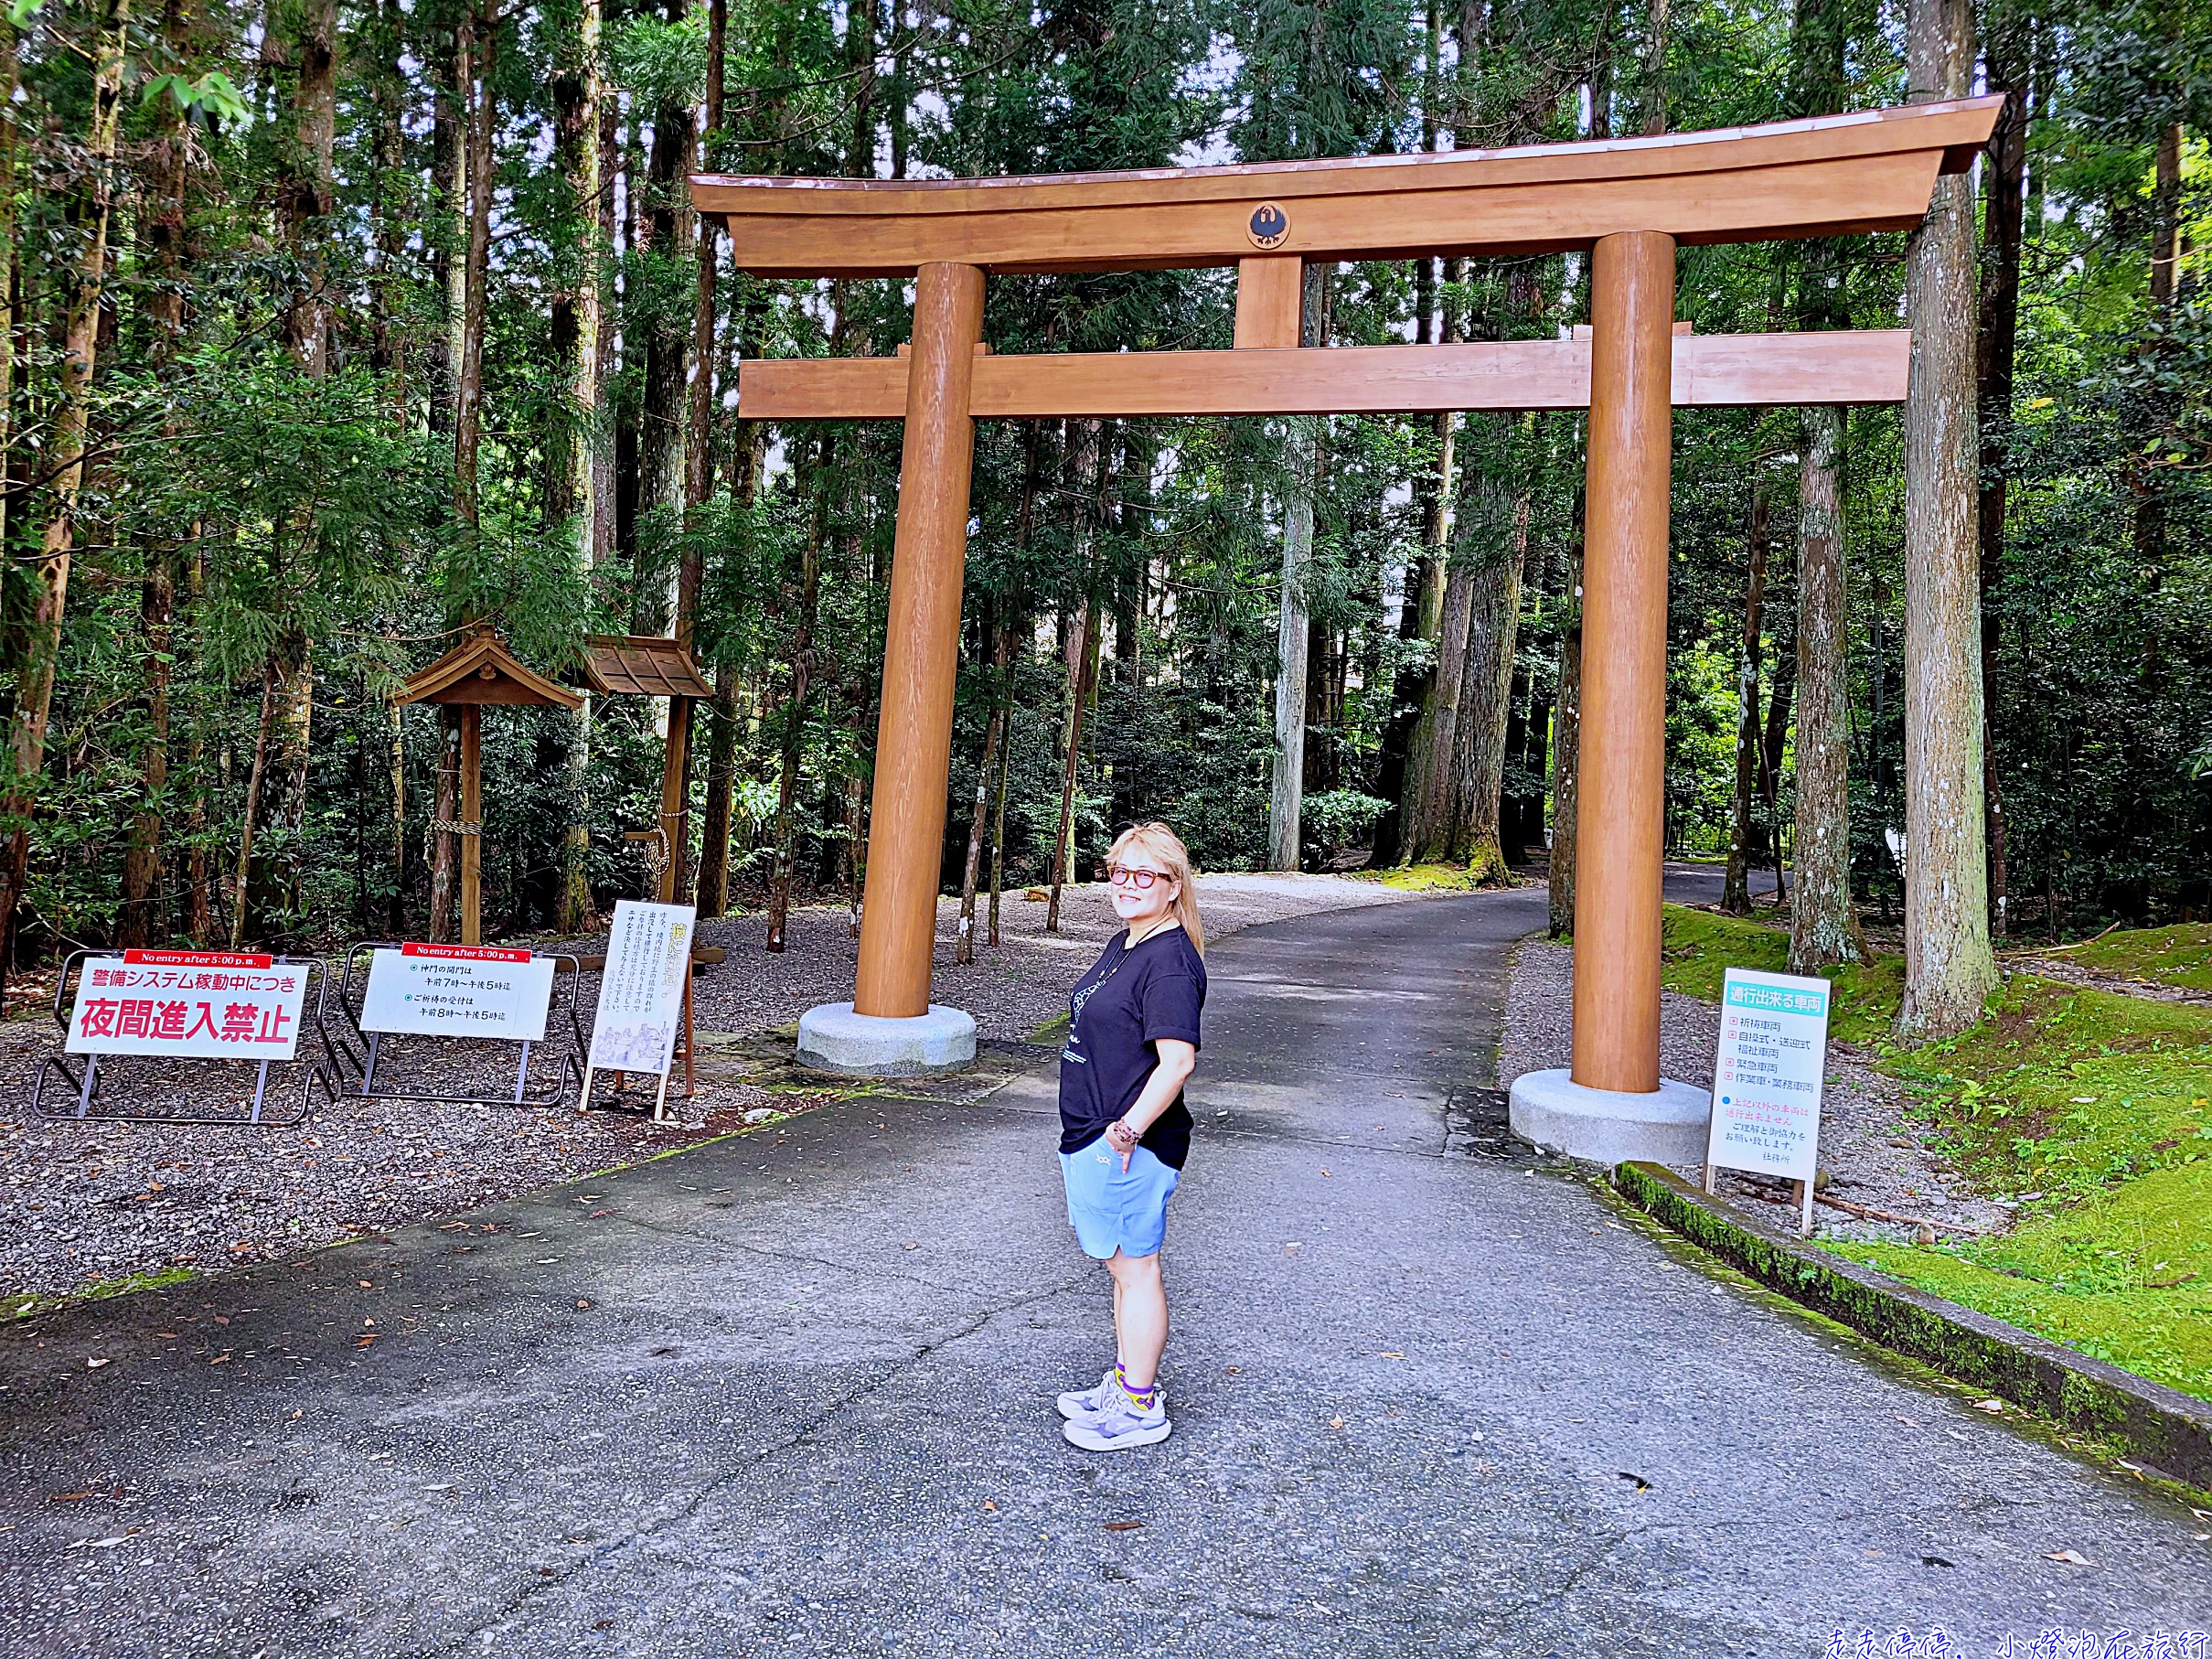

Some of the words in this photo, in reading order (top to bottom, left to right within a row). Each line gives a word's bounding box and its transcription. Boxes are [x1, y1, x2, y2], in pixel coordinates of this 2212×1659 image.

[142, 953, 155, 961] No
[156, 955, 183, 963] entry
[185, 955, 209, 964] after
[211, 956, 233, 964] 5:00
[235, 958, 257, 966] p.m.
[430, 947, 454, 956] entry
[454, 949, 476, 958] after
[478, 950, 497, 958] 5:00
[91, 969, 296, 993] 警備システム稼動中につき
[1730, 986, 1822, 1012] 通行出来る車両
[80, 997, 292, 1044] 夜間進入禁止
[1738, 1044, 1779, 1059] 福祉車両
[1736, 1059, 1778, 1074] 緊急車両
[1733, 1098, 1809, 1116] 上記以外の車両は
[1726, 1108, 1792, 1126] 通行出来ません
[1733, 1122, 1806, 1141] ご理解と御協力を
